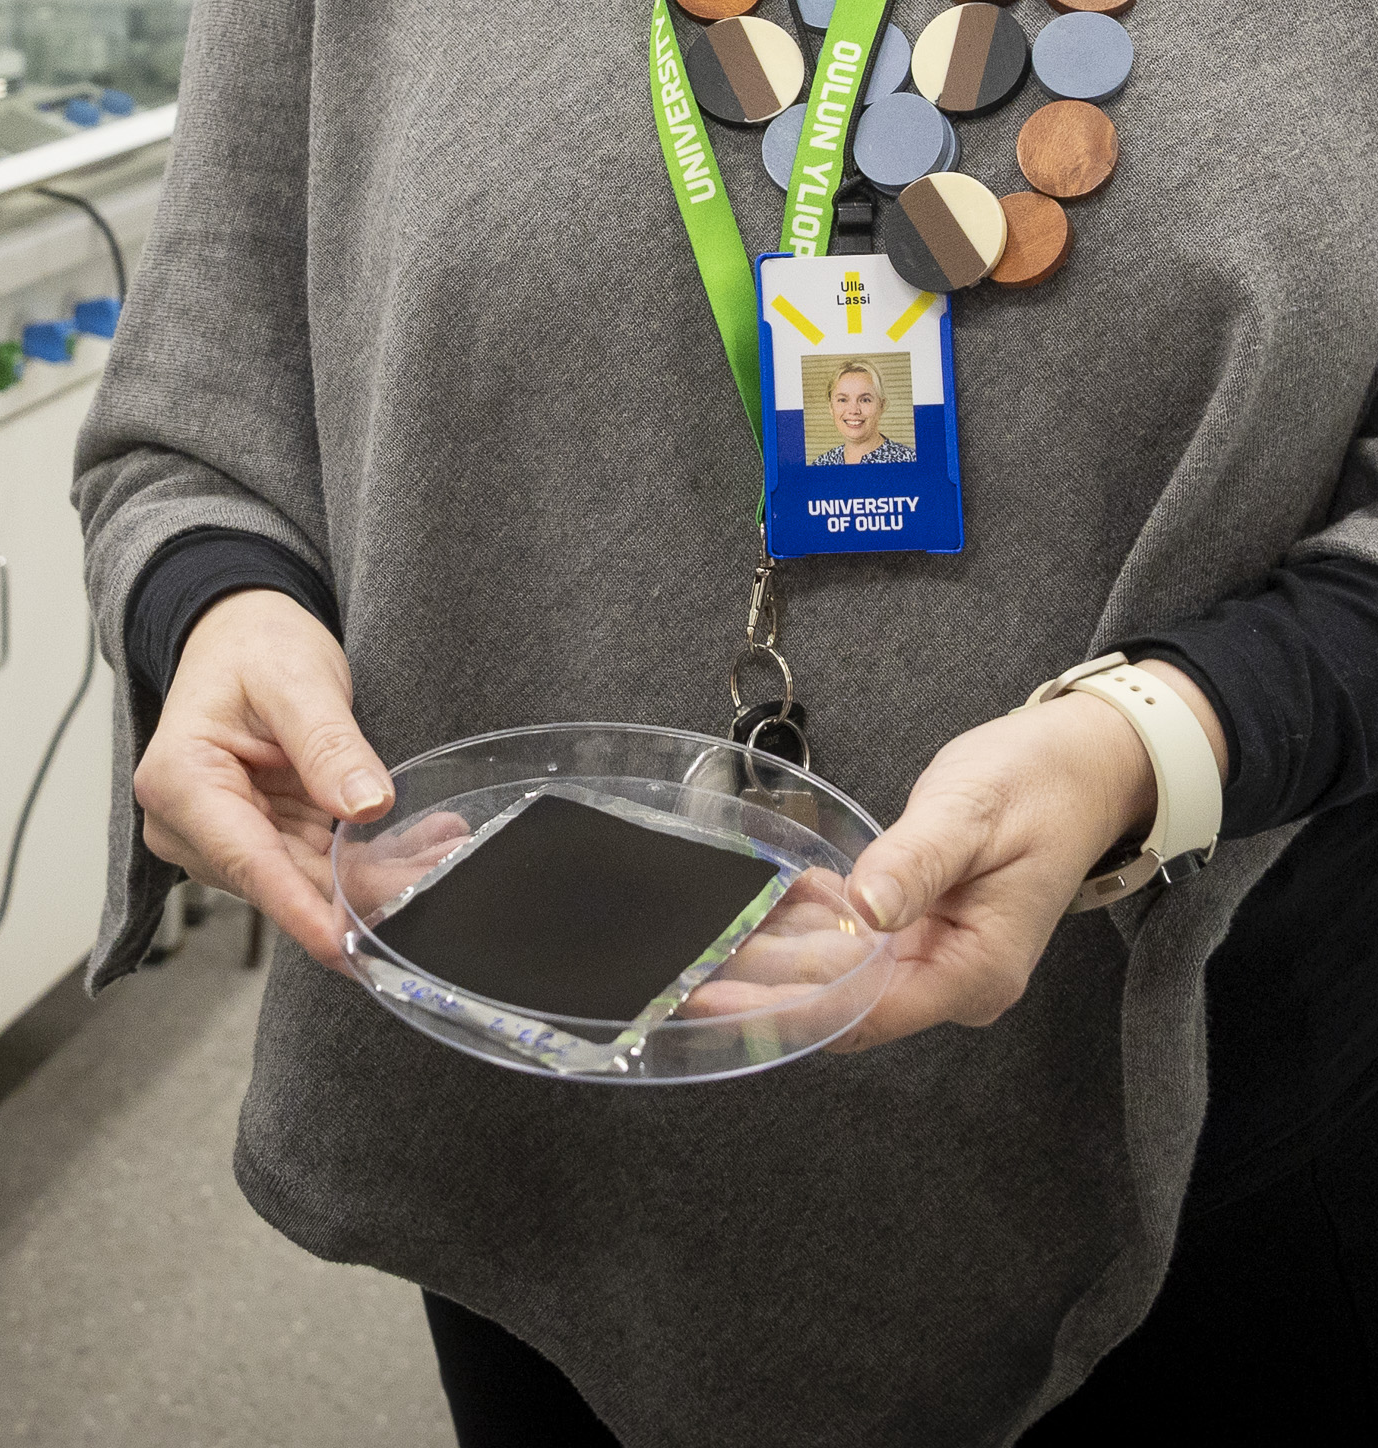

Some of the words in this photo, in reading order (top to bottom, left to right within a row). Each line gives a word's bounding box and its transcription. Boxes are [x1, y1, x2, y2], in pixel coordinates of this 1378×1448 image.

[809, 40, 863, 152] OULUN
[654, 14, 717, 205] UNIVERSITY
[840, 281, 865, 293] Ulla
[836, 293, 871, 306] Lassi
[807, 496, 920, 516] UNIVERSITY
[827, 516, 851, 533] OF
[855, 515, 904, 532] OULU
